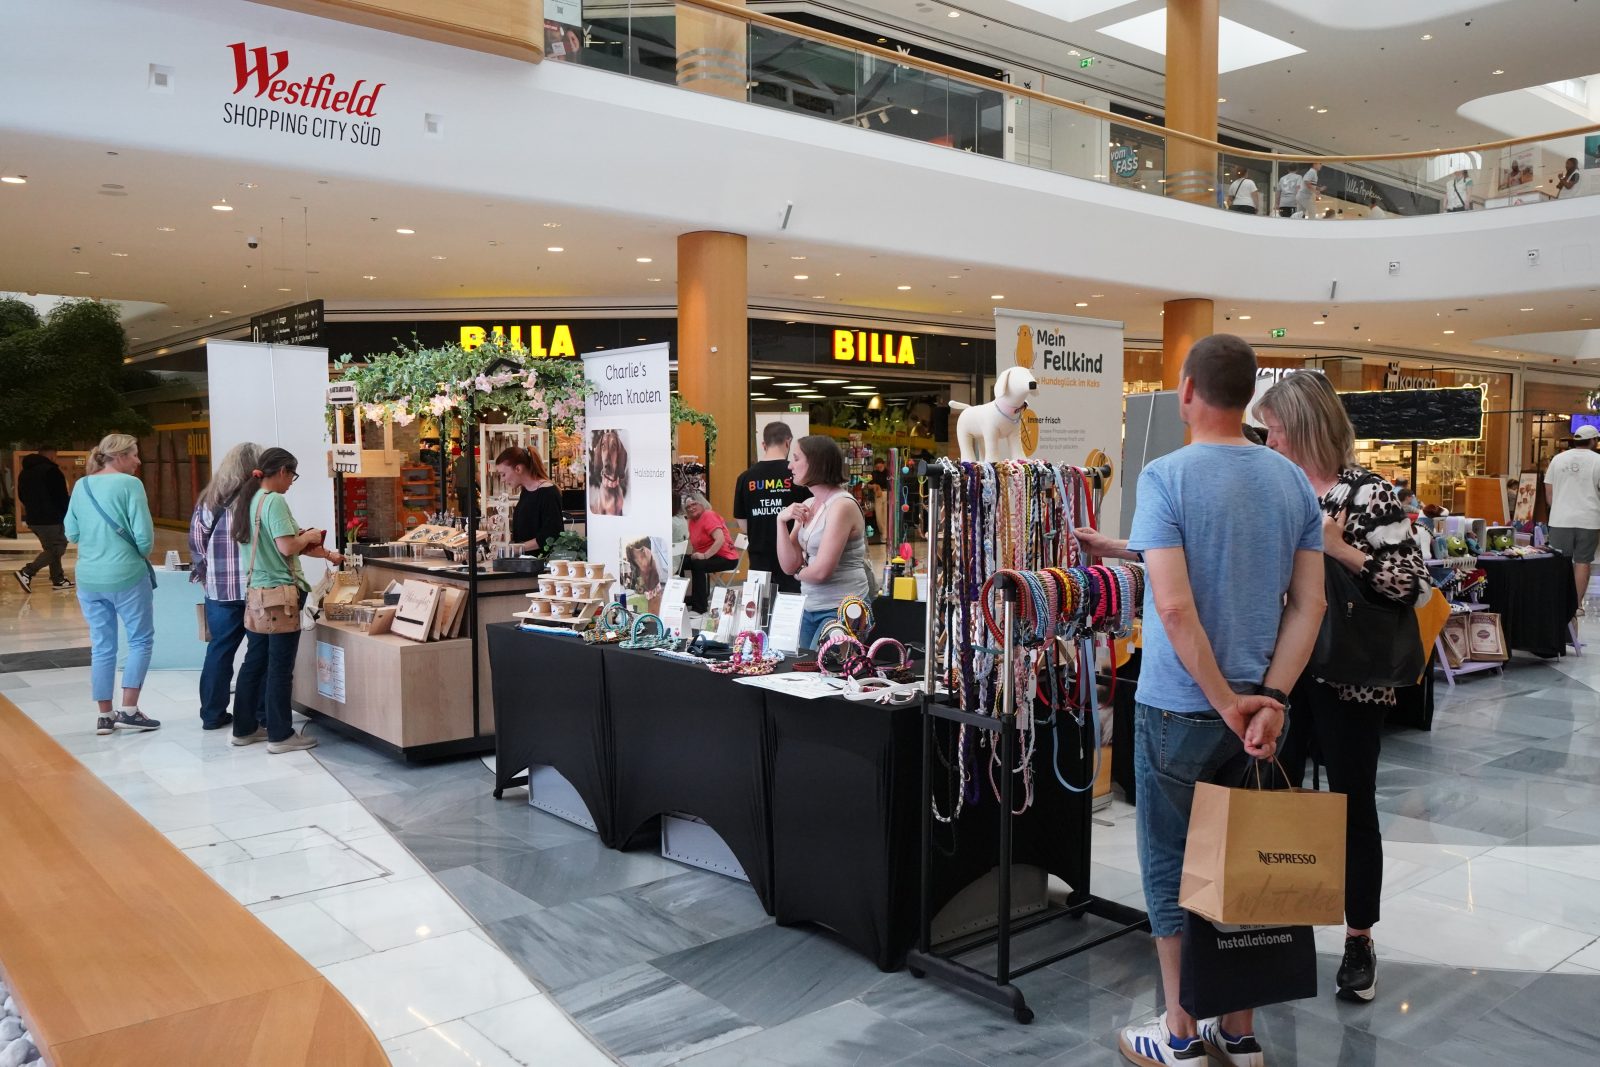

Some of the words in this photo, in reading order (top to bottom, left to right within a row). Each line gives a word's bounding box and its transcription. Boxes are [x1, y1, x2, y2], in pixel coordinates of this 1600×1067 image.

[226, 42, 387, 118] Westfield
[223, 102, 308, 136] SHOPPING
[312, 117, 347, 141] CITY
[350, 121, 381, 147] SÜD
[1111, 150, 1126, 160] vom
[1116, 157, 1139, 174] FASS
[460, 325, 576, 357] BILLA
[1037, 328, 1066, 347] Mein
[833, 329, 916, 365] BILLA
[1043, 349, 1103, 374] Fellkind
[605, 361, 647, 380] Charlie's
[1041, 376, 1077, 388] Hundeglück
[1087, 380, 1100, 389] Keks
[1400, 376, 1438, 390] karaca
[593, 390, 623, 411] Pfoten
[626, 388, 662, 404] Knoten
[1045, 416, 1061, 424] frisch
[748, 478, 792, 491] BUMAS
[760, 499, 782, 507] TEAM
[1257, 850, 1316, 865] NESPRESSO
[1217, 933, 1293, 950] Installationen
